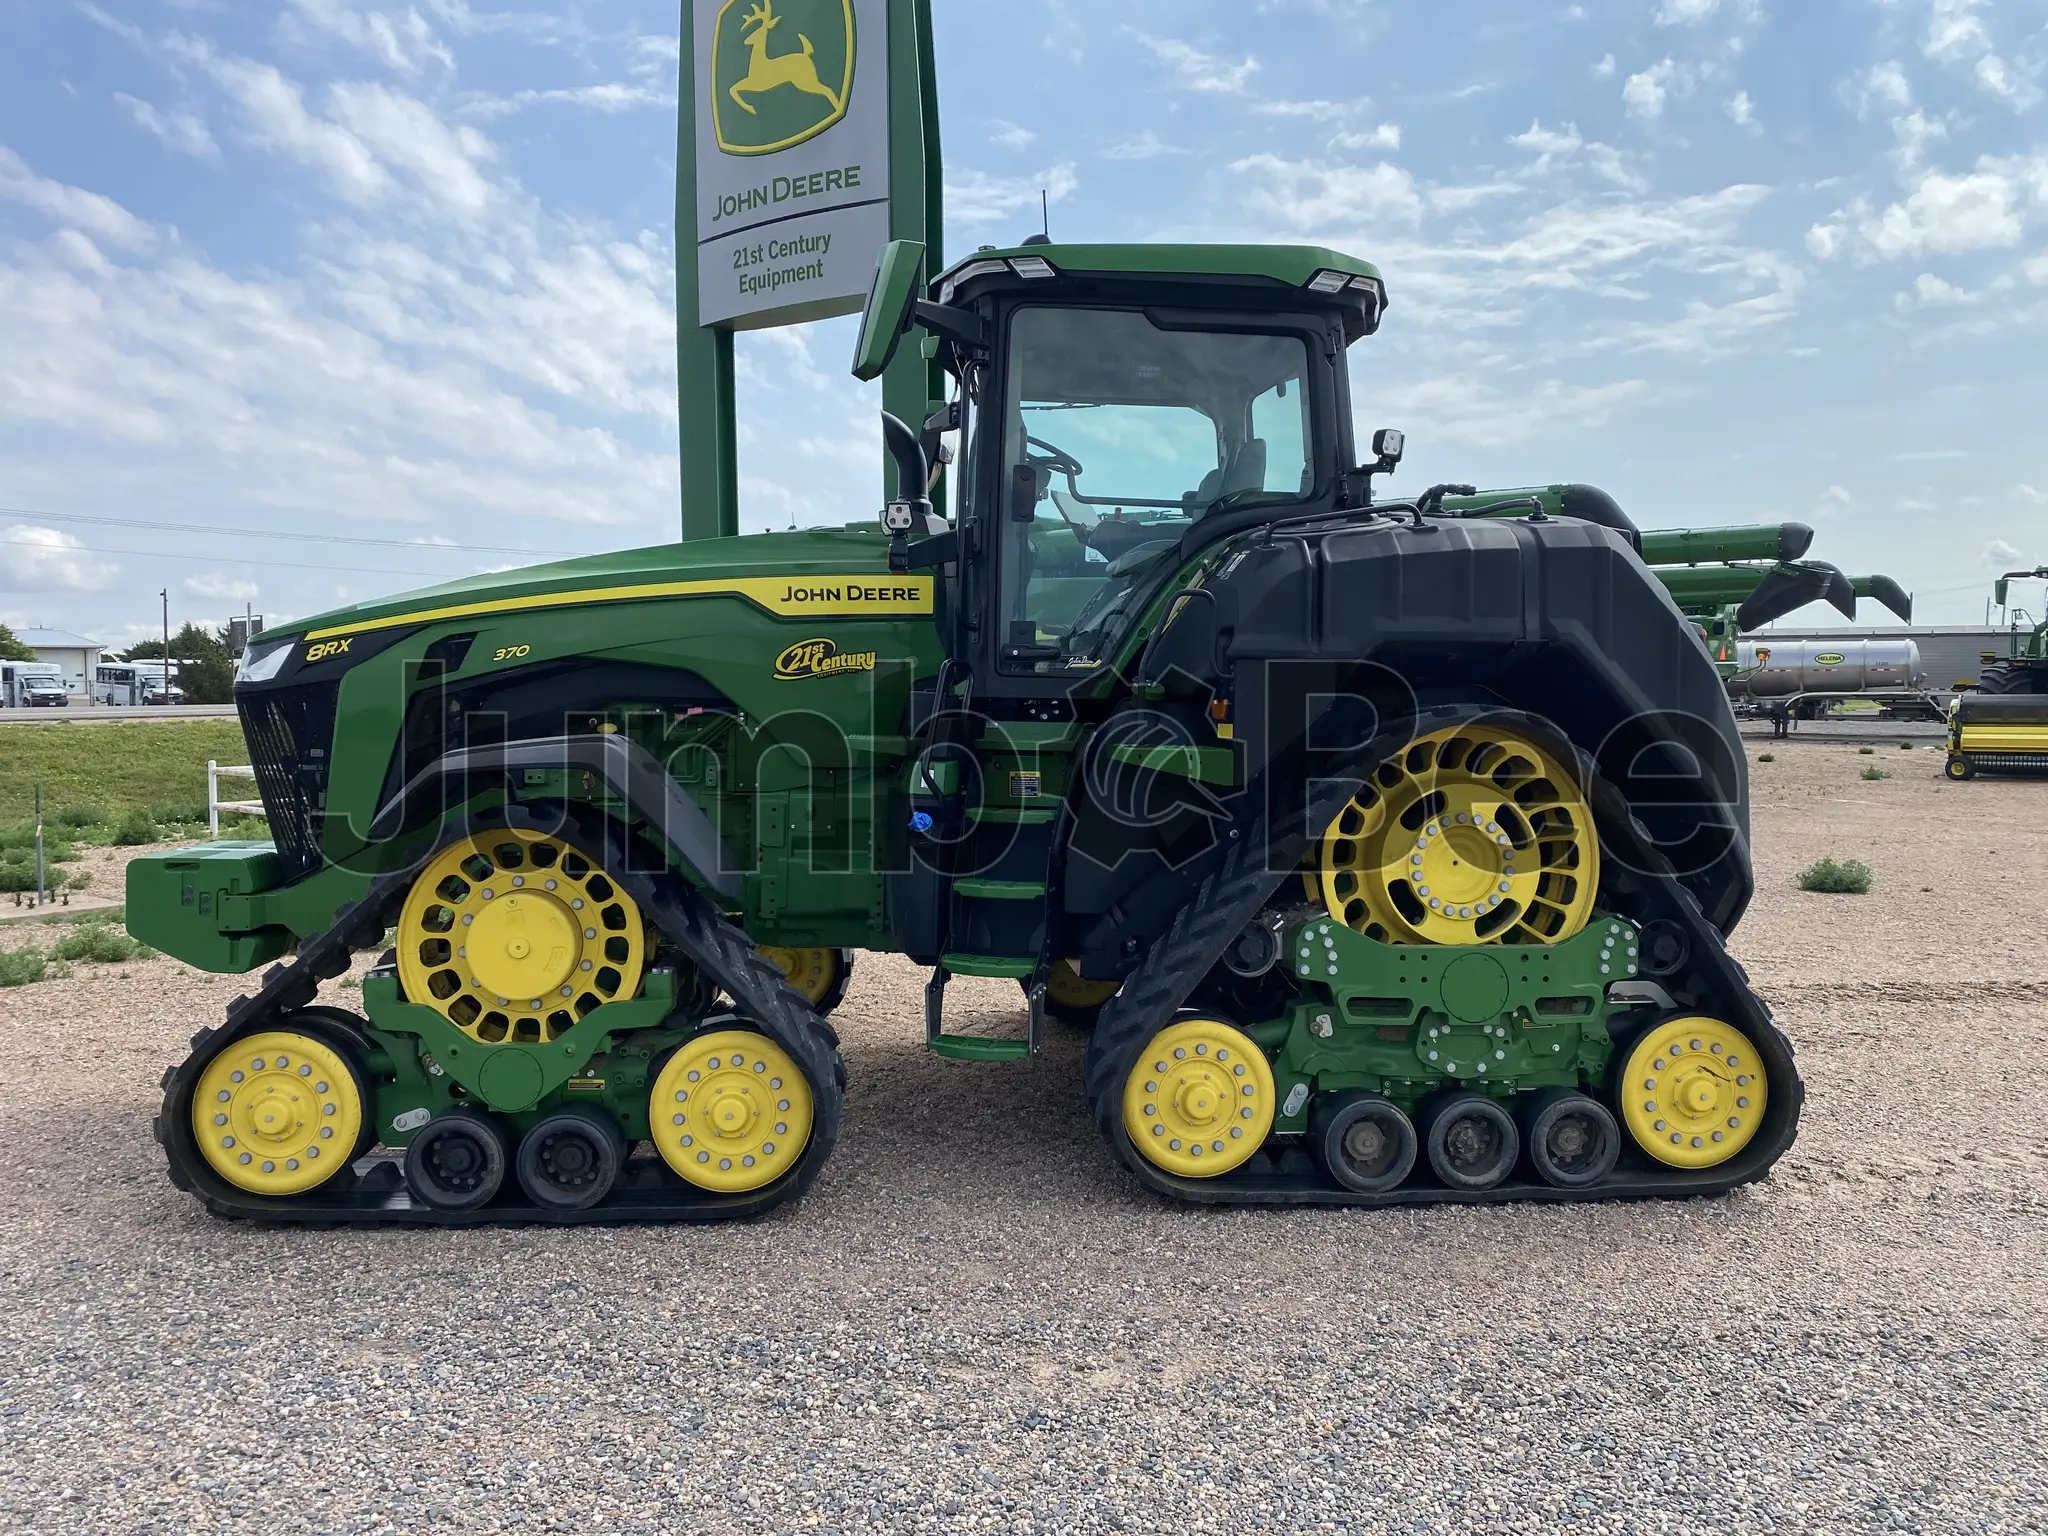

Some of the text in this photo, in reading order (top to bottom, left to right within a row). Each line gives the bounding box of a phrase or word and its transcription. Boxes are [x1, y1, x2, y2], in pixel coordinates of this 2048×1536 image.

[733, 233, 832, 270] 21st Century
[739, 258, 824, 296] Equipment
[305, 638, 353, 662] 8RX
[493, 644, 531, 661] 370
